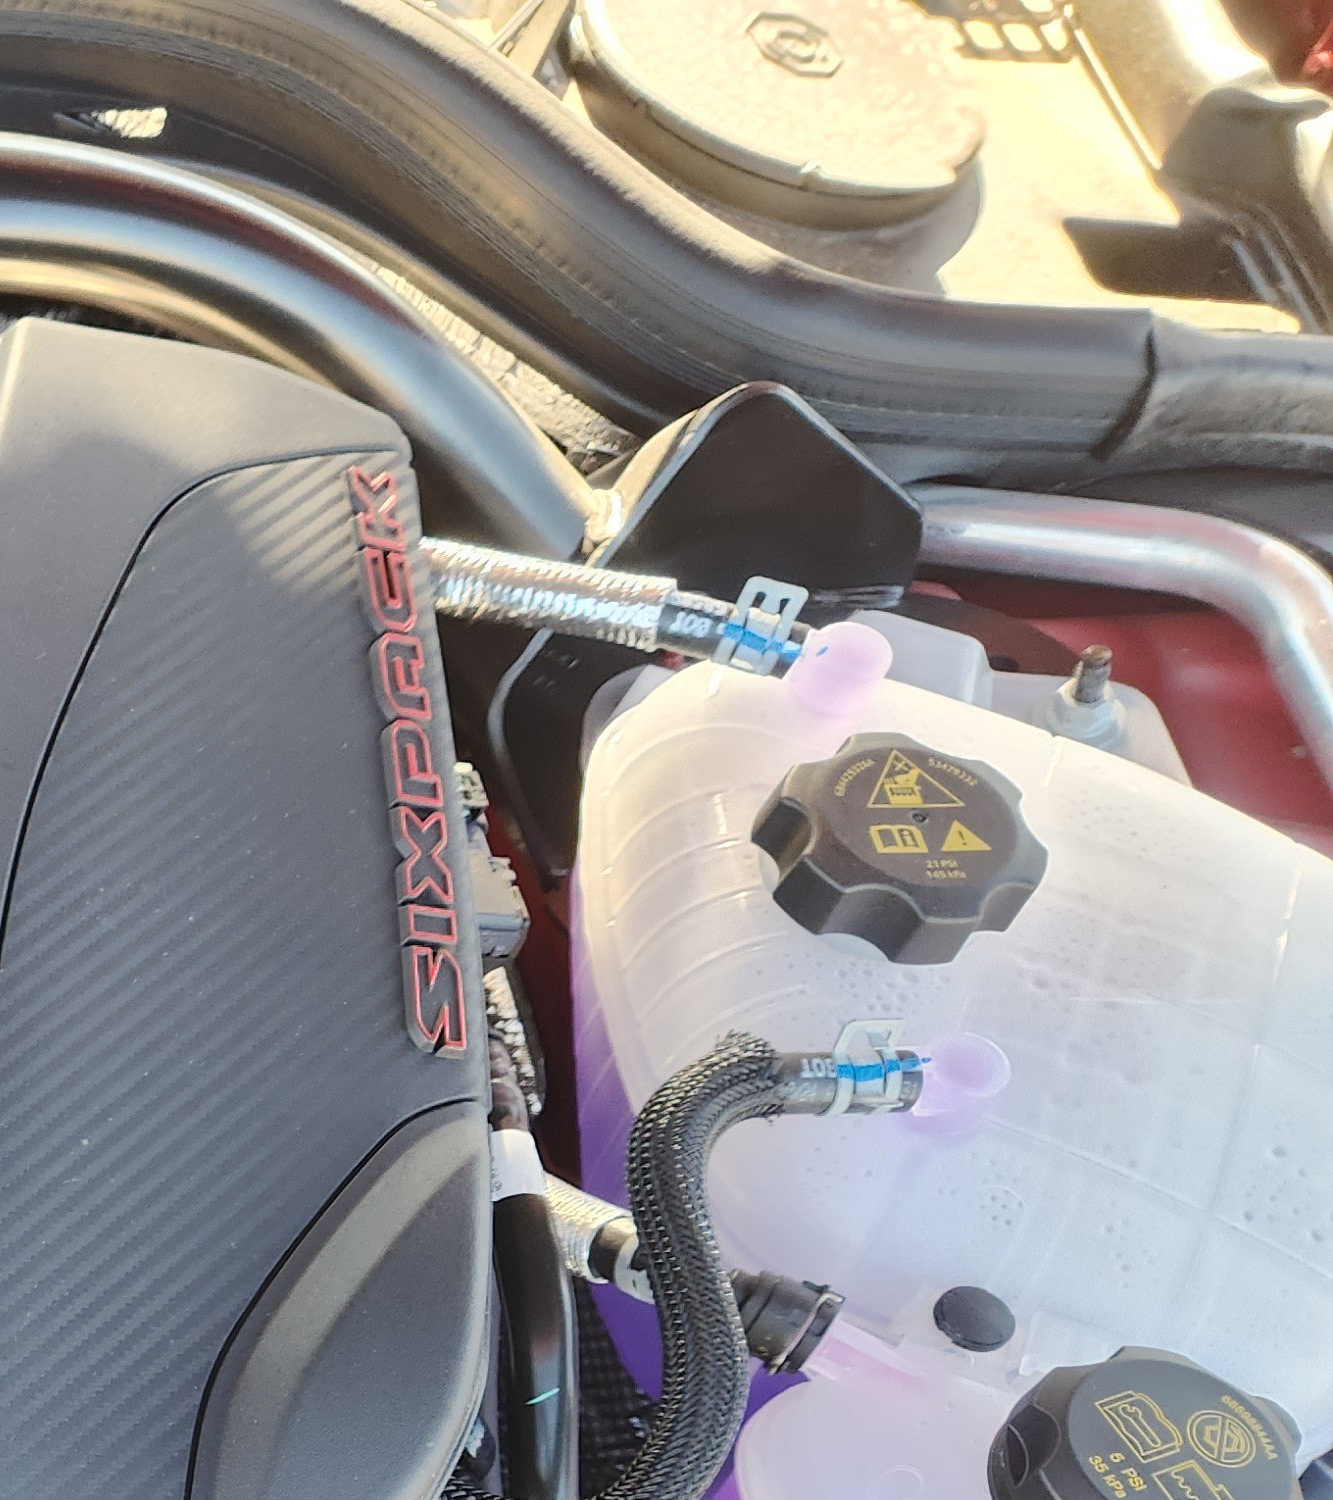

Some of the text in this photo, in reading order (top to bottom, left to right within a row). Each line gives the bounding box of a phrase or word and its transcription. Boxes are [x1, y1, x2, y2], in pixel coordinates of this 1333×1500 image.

[347, 465, 466, 1057] SIXPACK
[1088, 1455, 1127, 1498] 35 kPa
[1109, 1452, 1147, 1491] 5 PSI
